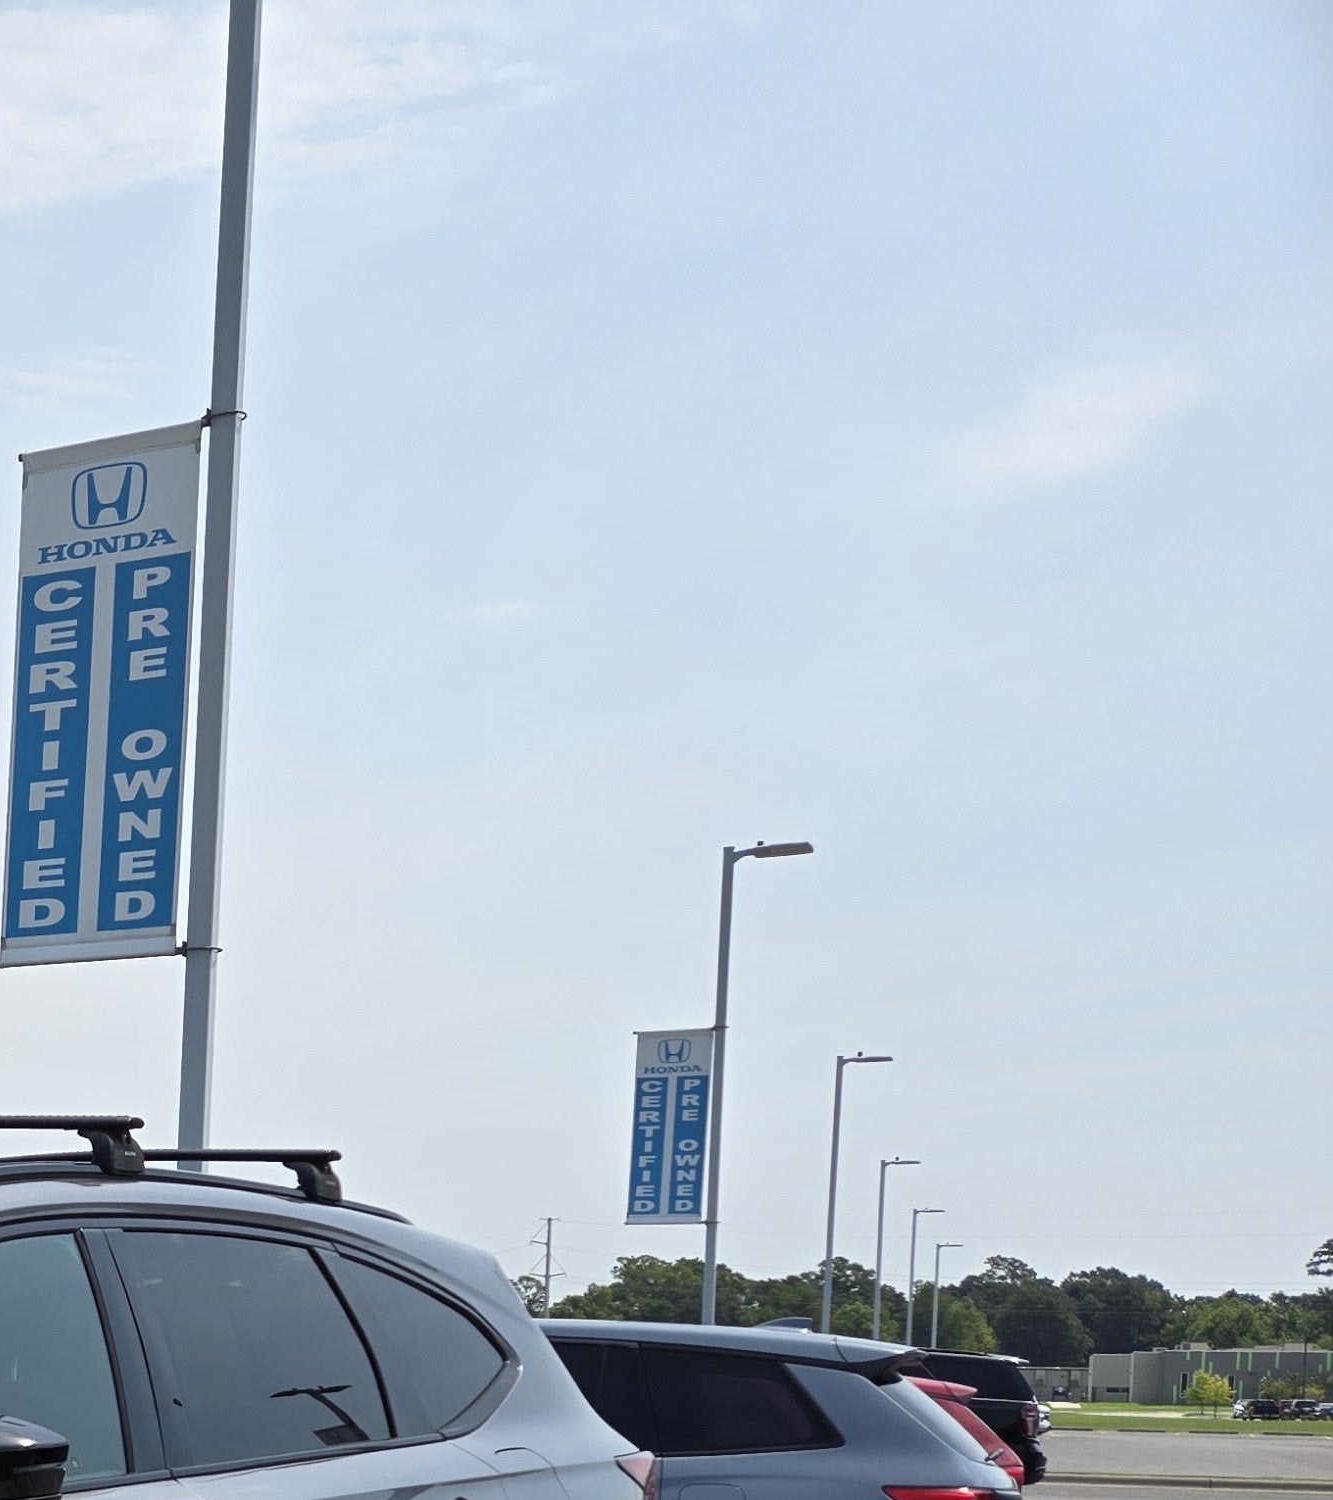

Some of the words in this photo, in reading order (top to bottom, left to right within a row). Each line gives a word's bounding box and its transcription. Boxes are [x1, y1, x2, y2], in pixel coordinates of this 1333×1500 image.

[37, 527, 177, 565] HONDA
[126, 565, 172, 683] PRE
[18, 579, 83, 930] CERTIFIED
[112, 729, 173, 923] OWNED
[643, 1064, 703, 1075] HONDA
[681, 1079, 702, 1121] PRE
[633, 1080, 663, 1212] CERTIFIED
[675, 1138, 700, 1211] OWNED
